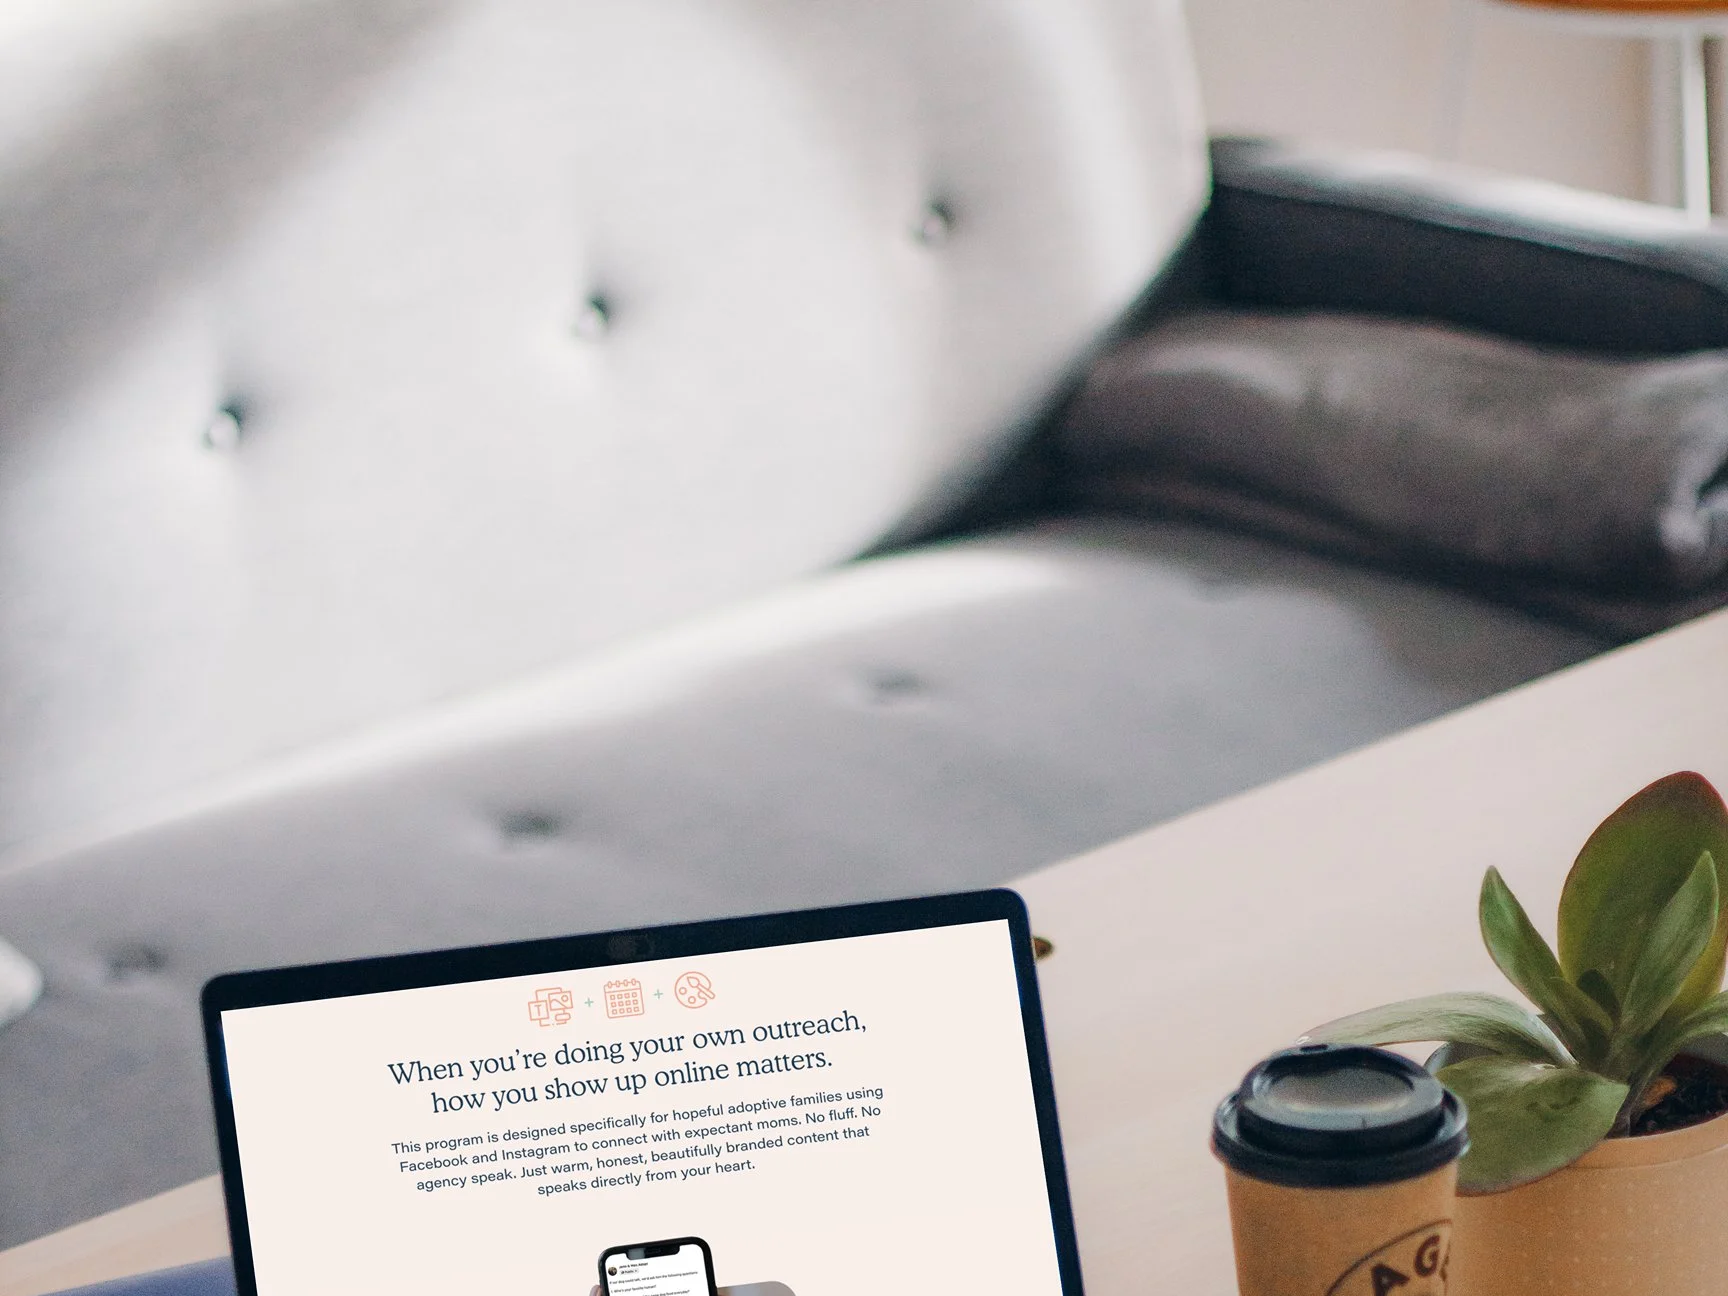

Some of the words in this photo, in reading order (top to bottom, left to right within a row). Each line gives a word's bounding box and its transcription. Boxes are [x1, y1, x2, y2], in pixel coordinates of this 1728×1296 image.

[387, 1060, 464, 1085] When
[469, 1049, 547, 1080] you’re
[554, 1041, 624, 1066] doing
[630, 1035, 685, 1062] your
[692, 1028, 745, 1049] own
[753, 1010, 867, 1041] outreach,
[431, 1091, 486, 1113] how
[491, 1086, 538, 1111] you
[545, 1077, 608, 1100] show
[615, 1074, 647, 1095] up
[655, 1062, 730, 1087] online
[737, 1052, 833, 1077] matters.
[391, 1140, 421, 1154] This
[426, 1135, 484, 1153] program
[487, 1131, 499, 1143] is
[503, 1122, 566, 1141] designed
[570, 1114, 647, 1135] specifically
[650, 1111, 670, 1124] for
[673, 1103, 724, 1121] hopeful
[728, 1098, 787, 1115] adoptive
[790, 1091, 843, 1108] families
[846, 1087, 884, 1102] using
[400, 1154, 468, 1172] Facebook
[472, 1151, 498, 1165] and
[501, 1144, 571, 1161] Instagram
[573, 1141, 588, 1152] to
[592, 1133, 648, 1149] connect
[651, 1129, 681, 1142] with
[684, 1121, 754, 1139] expectant
[757, 1117, 802, 1130] moms.
[805, 1112, 825, 1124] No
[828, 1107, 858, 1120] fluff.
[861, 1106, 881, 1118] No
[416, 1177, 467, 1193] agency
[471, 1168, 517, 1186] speak.
[520, 1165, 548, 1178] Just
[551, 1161, 593, 1175] warm,
[597, 1154, 648, 1168] honest,
[651, 1144, 722, 1163] beautifully
[726, 1135, 784, 1153] branded
[787, 1130, 840, 1146] content
[842, 1126, 870, 1139] that
[537, 1180, 587, 1196] speaks
[591, 1172, 642, 1189] directly
[645, 1170, 677, 1182] from
[681, 1166, 712, 1181] your
[714, 1159, 756, 1173] heart.
